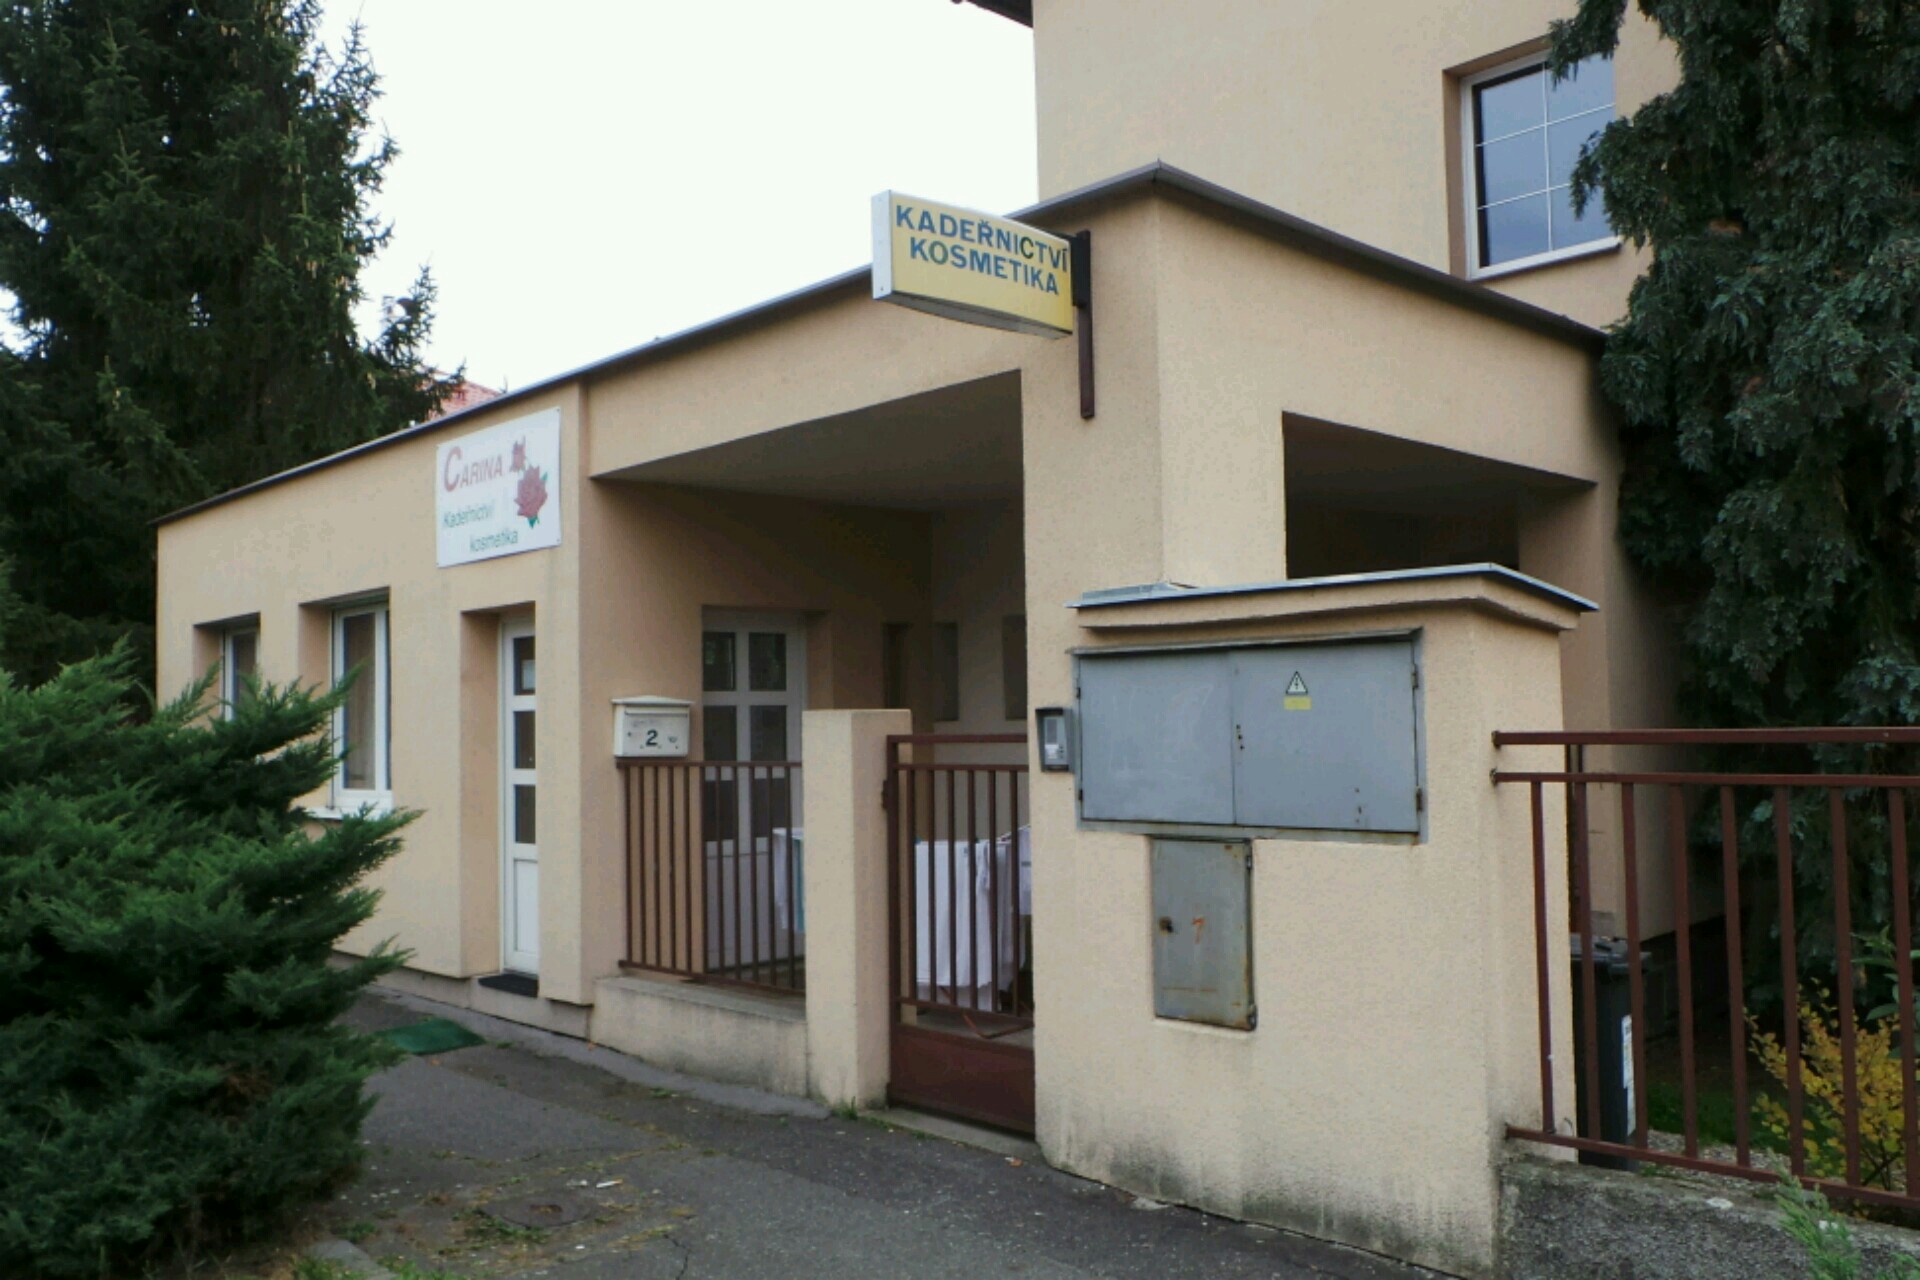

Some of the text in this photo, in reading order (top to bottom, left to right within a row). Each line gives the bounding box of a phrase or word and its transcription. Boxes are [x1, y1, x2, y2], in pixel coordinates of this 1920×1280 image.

[896, 204, 1068, 273] KADEŘNICTVÍ
[910, 236, 1059, 295] KOSMETIKA
[444, 446, 503, 492] CARINA
[646, 729, 659, 746] 2
